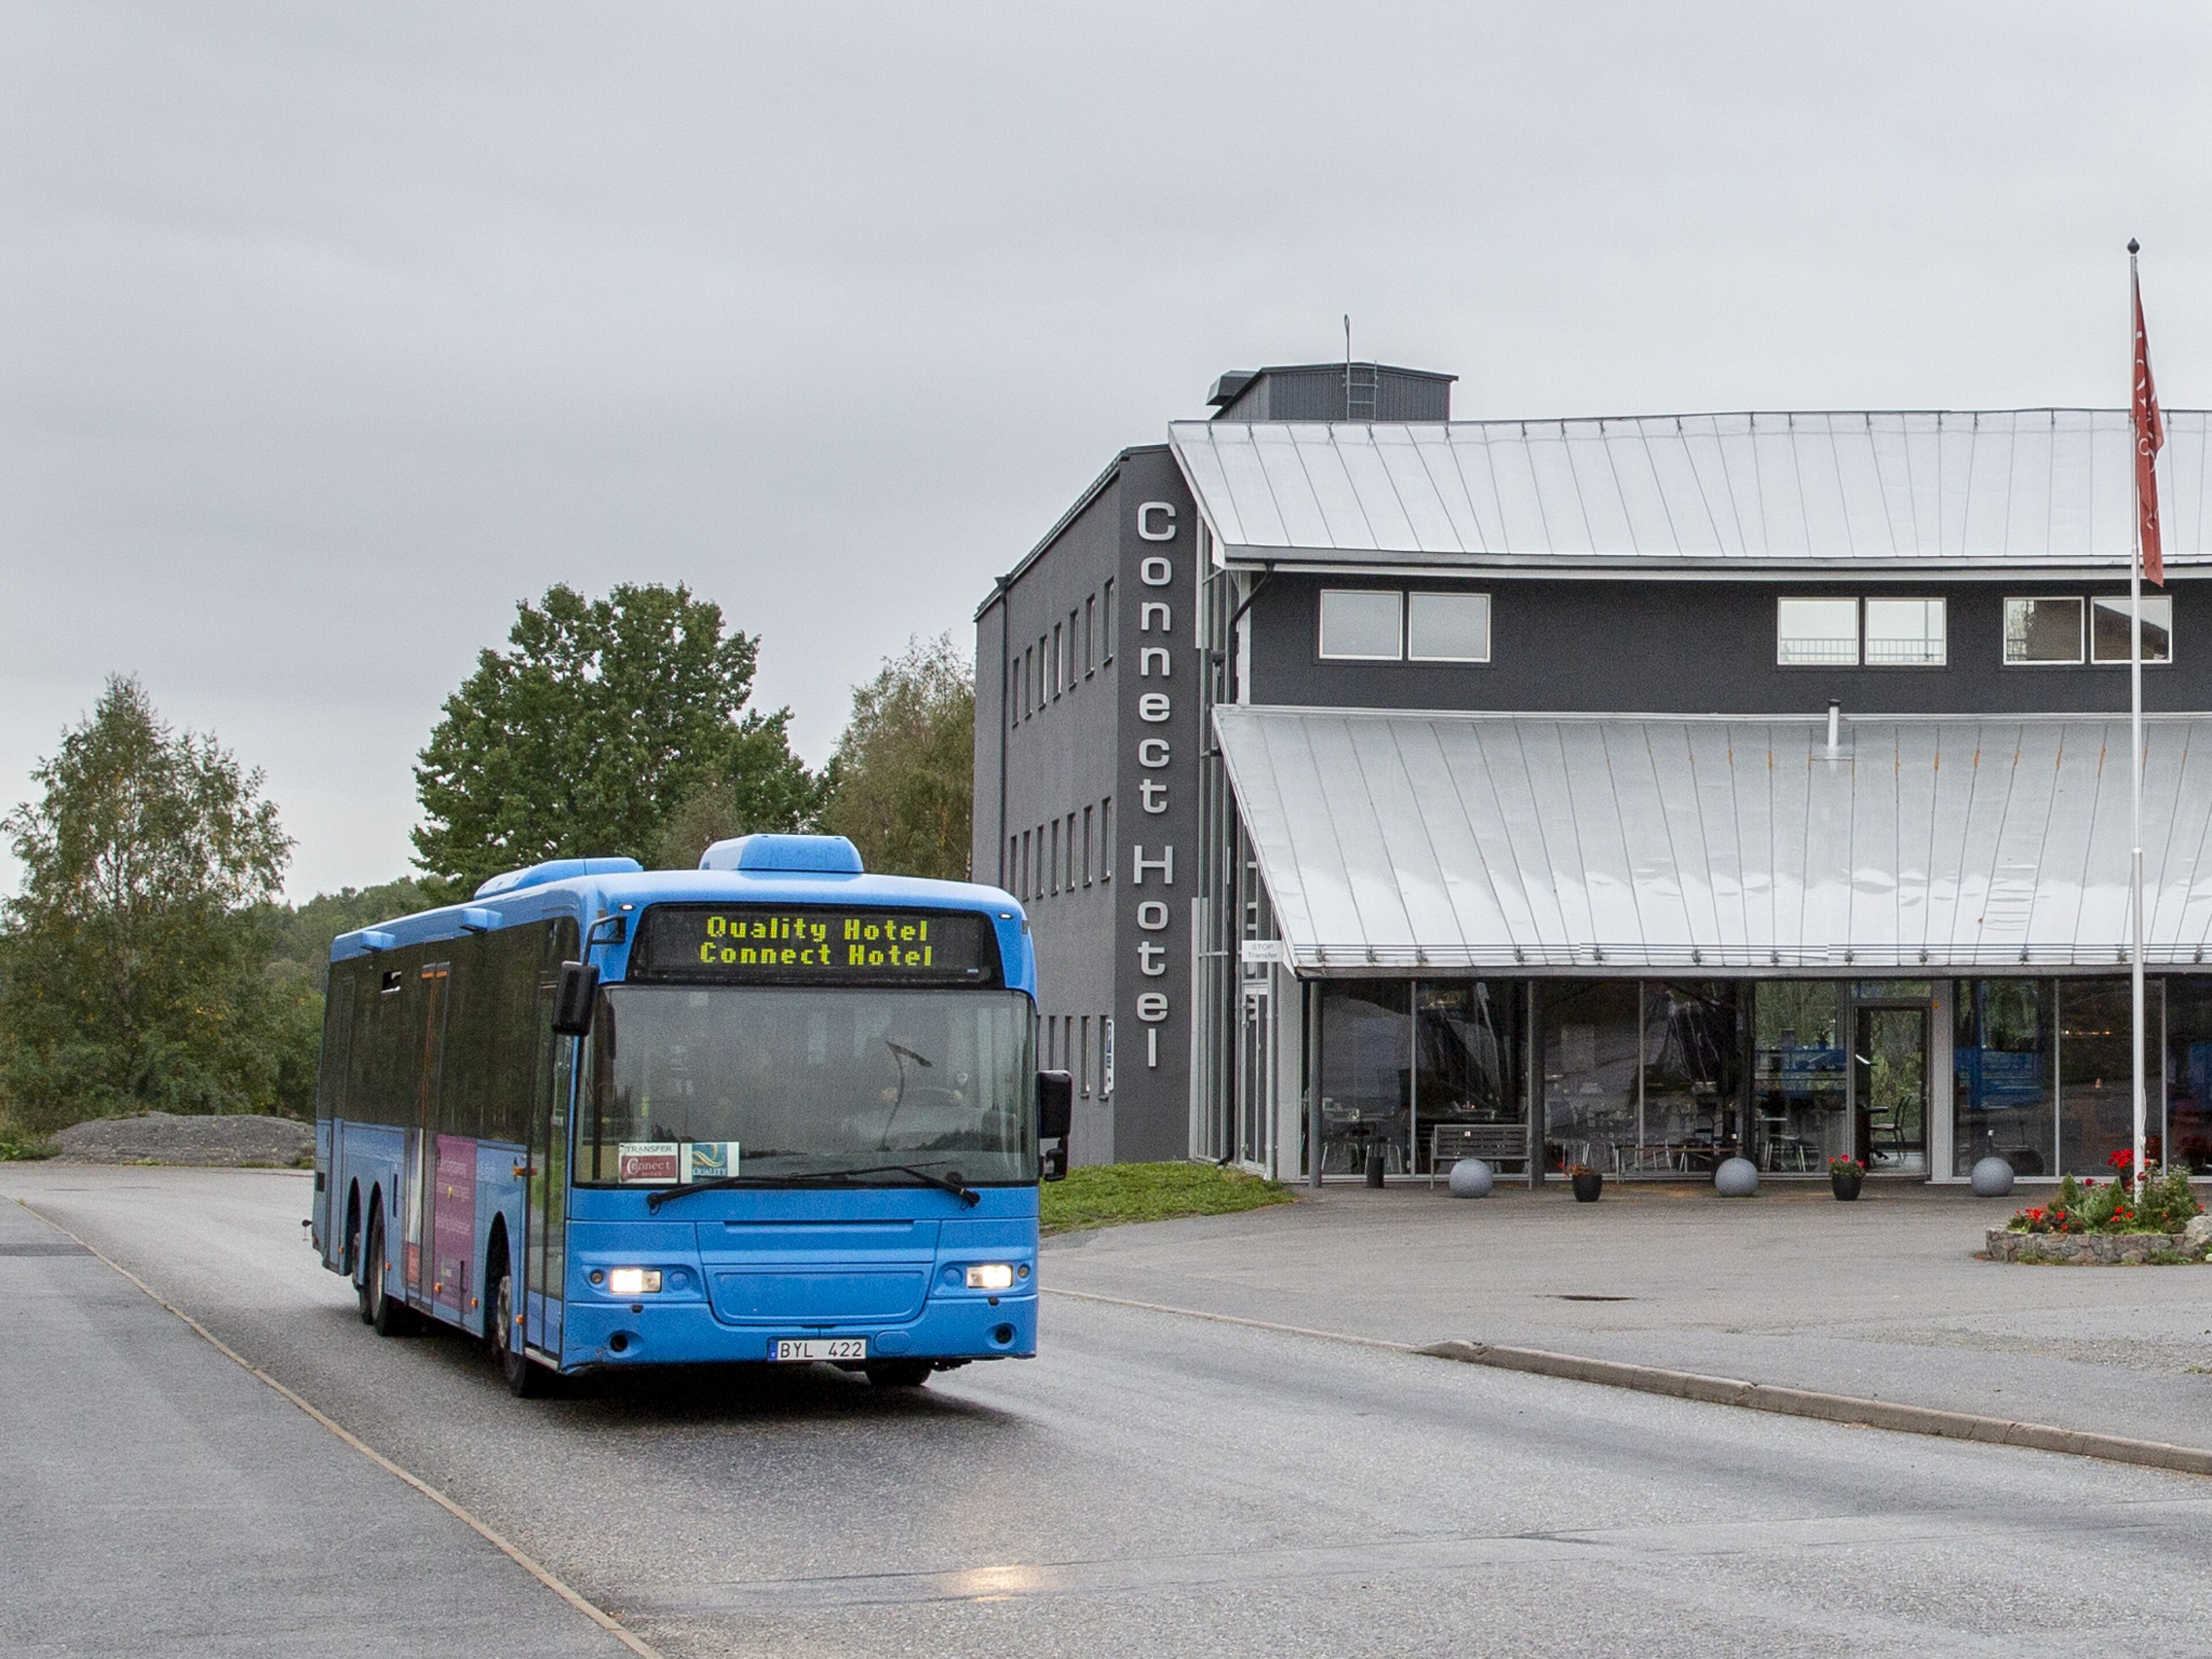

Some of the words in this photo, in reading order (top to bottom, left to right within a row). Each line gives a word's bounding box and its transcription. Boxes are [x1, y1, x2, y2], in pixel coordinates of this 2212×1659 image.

[1137, 501, 1177, 814] Connect
[706, 916, 827, 942] Quality
[844, 919, 928, 942] Hotel
[699, 942, 831, 965] Connect
[849, 944, 933, 967] Hotel
[1132, 844, 1174, 1067] Hotel
[626, 1145, 672, 1153] TRANSFER
[627, 1158, 672, 1175] Connect
[693, 1168, 726, 1176] QUALITY
[781, 1342, 813, 1358] BYL
[828, 1342, 862, 1357] 422
